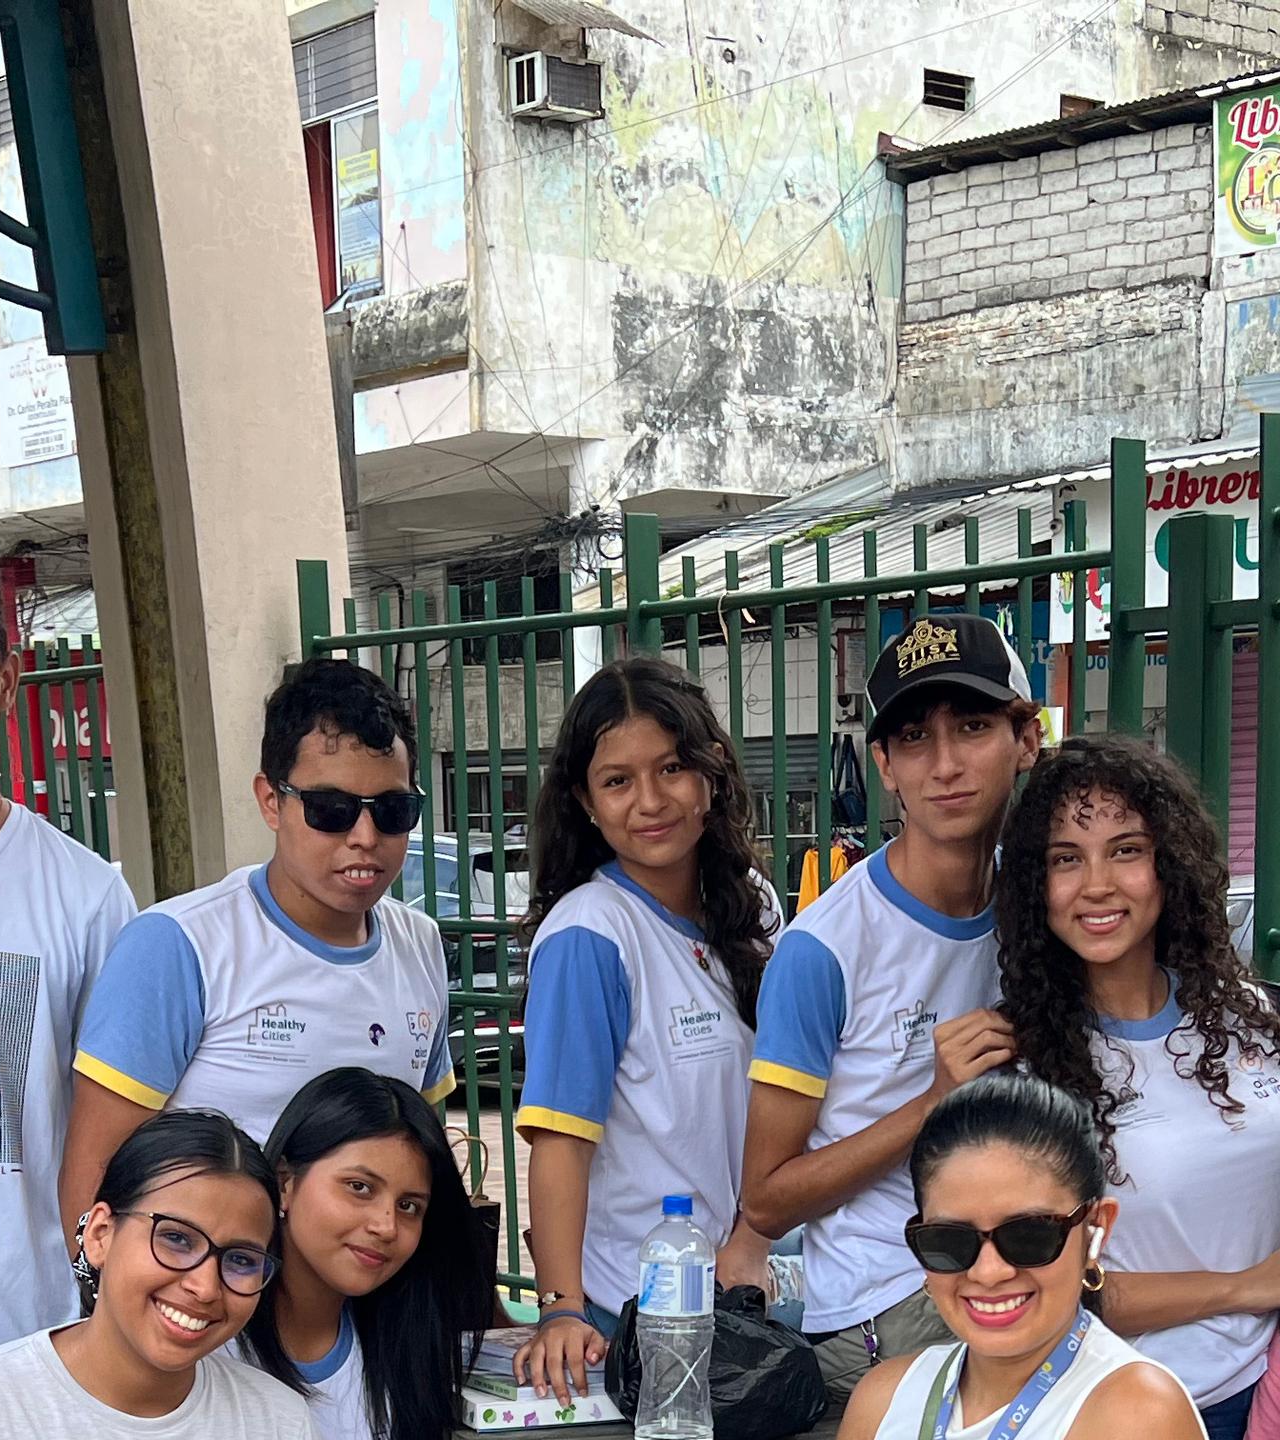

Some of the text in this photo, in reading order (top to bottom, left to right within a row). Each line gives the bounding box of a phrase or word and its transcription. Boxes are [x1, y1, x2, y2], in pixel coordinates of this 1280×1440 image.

[261, 1018, 306, 1033] Healthy
[680, 1011, 721, 1027] Healthy
[261, 1030, 291, 1042] Cities
[683, 1025, 713, 1038] Cities
